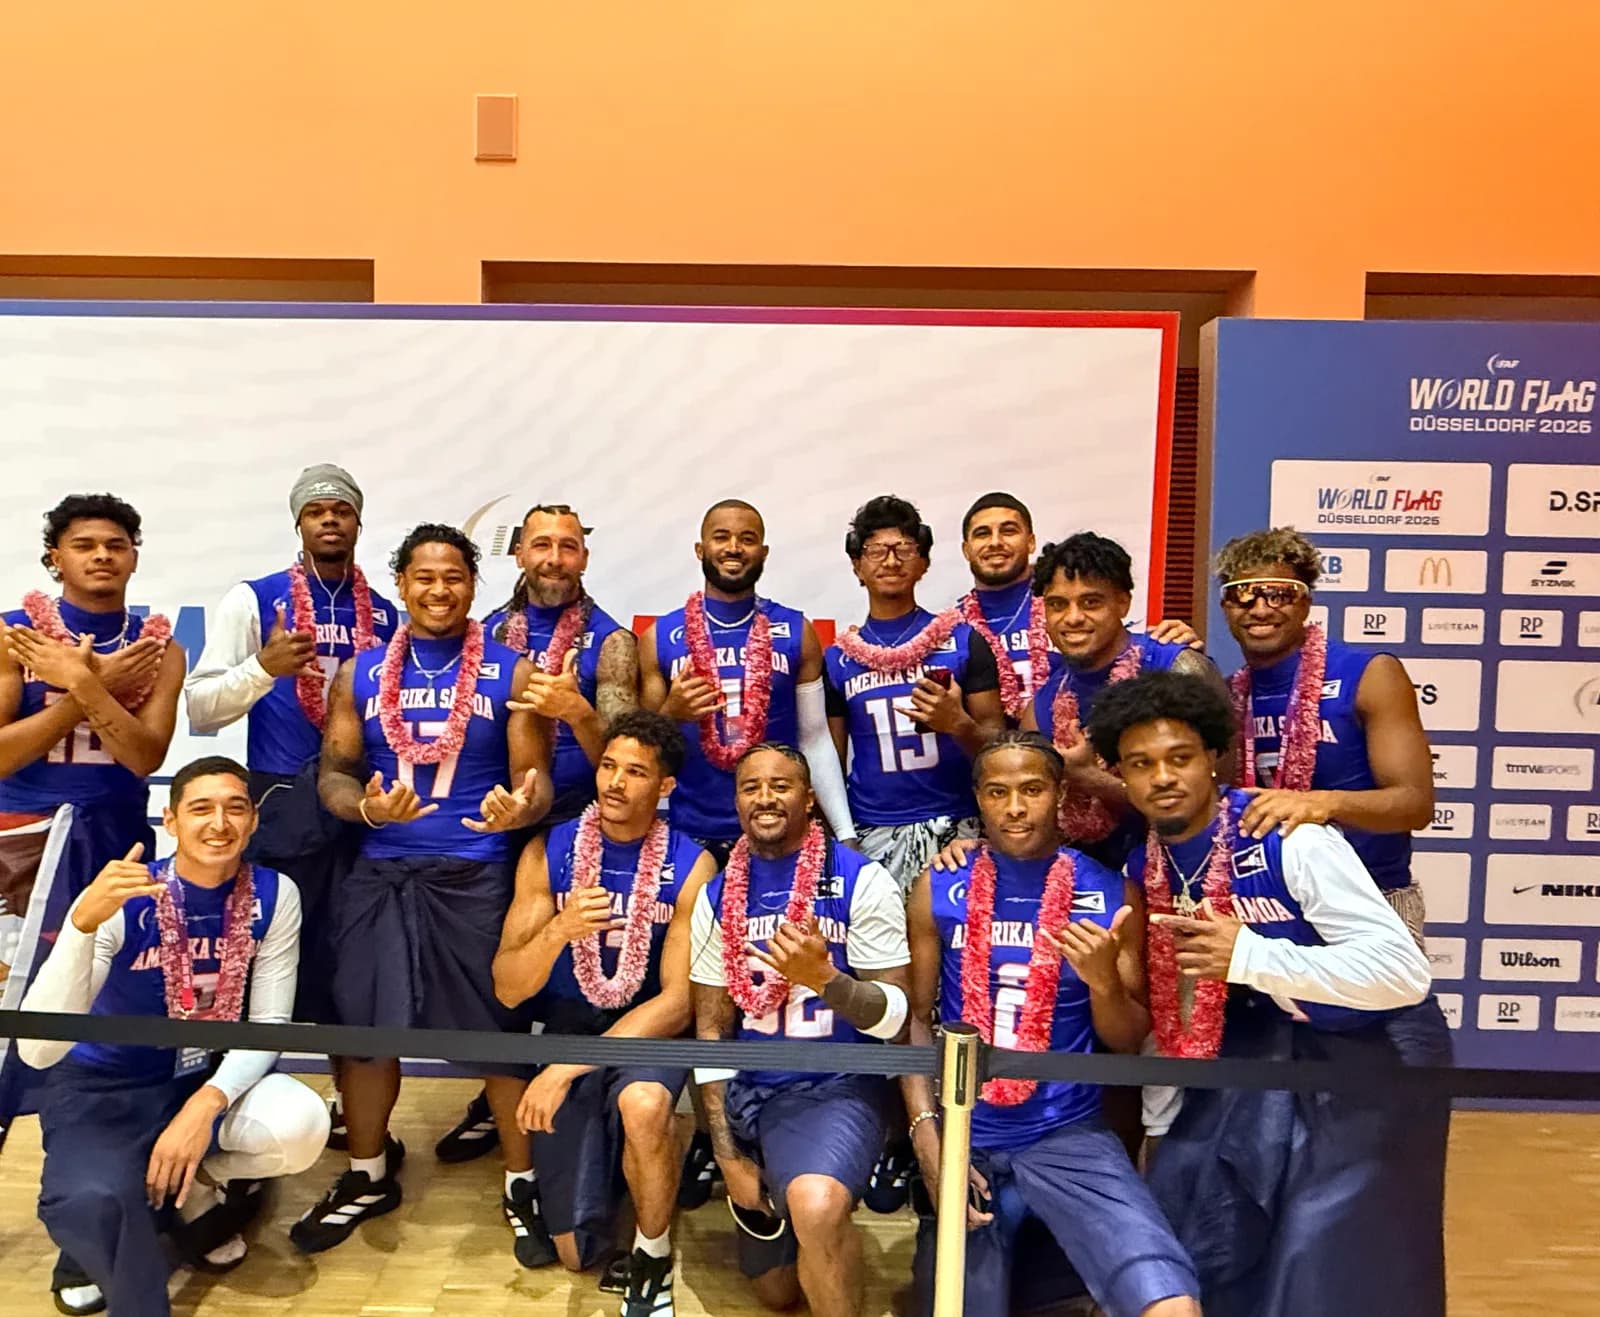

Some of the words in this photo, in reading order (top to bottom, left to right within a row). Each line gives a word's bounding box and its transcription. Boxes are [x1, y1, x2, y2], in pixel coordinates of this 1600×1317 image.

[1410, 377, 1516, 411] WORLD
[1520, 379, 1597, 414] FLAG
[1409, 414, 1536, 432] DÜSSELDORF
[1538, 418, 1593, 433] 2026
[1318, 487, 1388, 510] WORLD
[1392, 489, 1443, 512] FLAG
[1318, 512, 1403, 525] DÜSSELDORF
[1363, 613, 1387, 631] RP
[1519, 616, 1544, 632] RP
[844, 669, 905, 701] AMERIKA
[364, 687, 437, 720] ARIKA
[864, 694, 940, 774] 15
[1432, 809, 1454, 824] RP
[1230, 895, 1297, 924] AMOA
[1499, 951, 1561, 968] Wilson
[1497, 1001, 1521, 1018] RP
